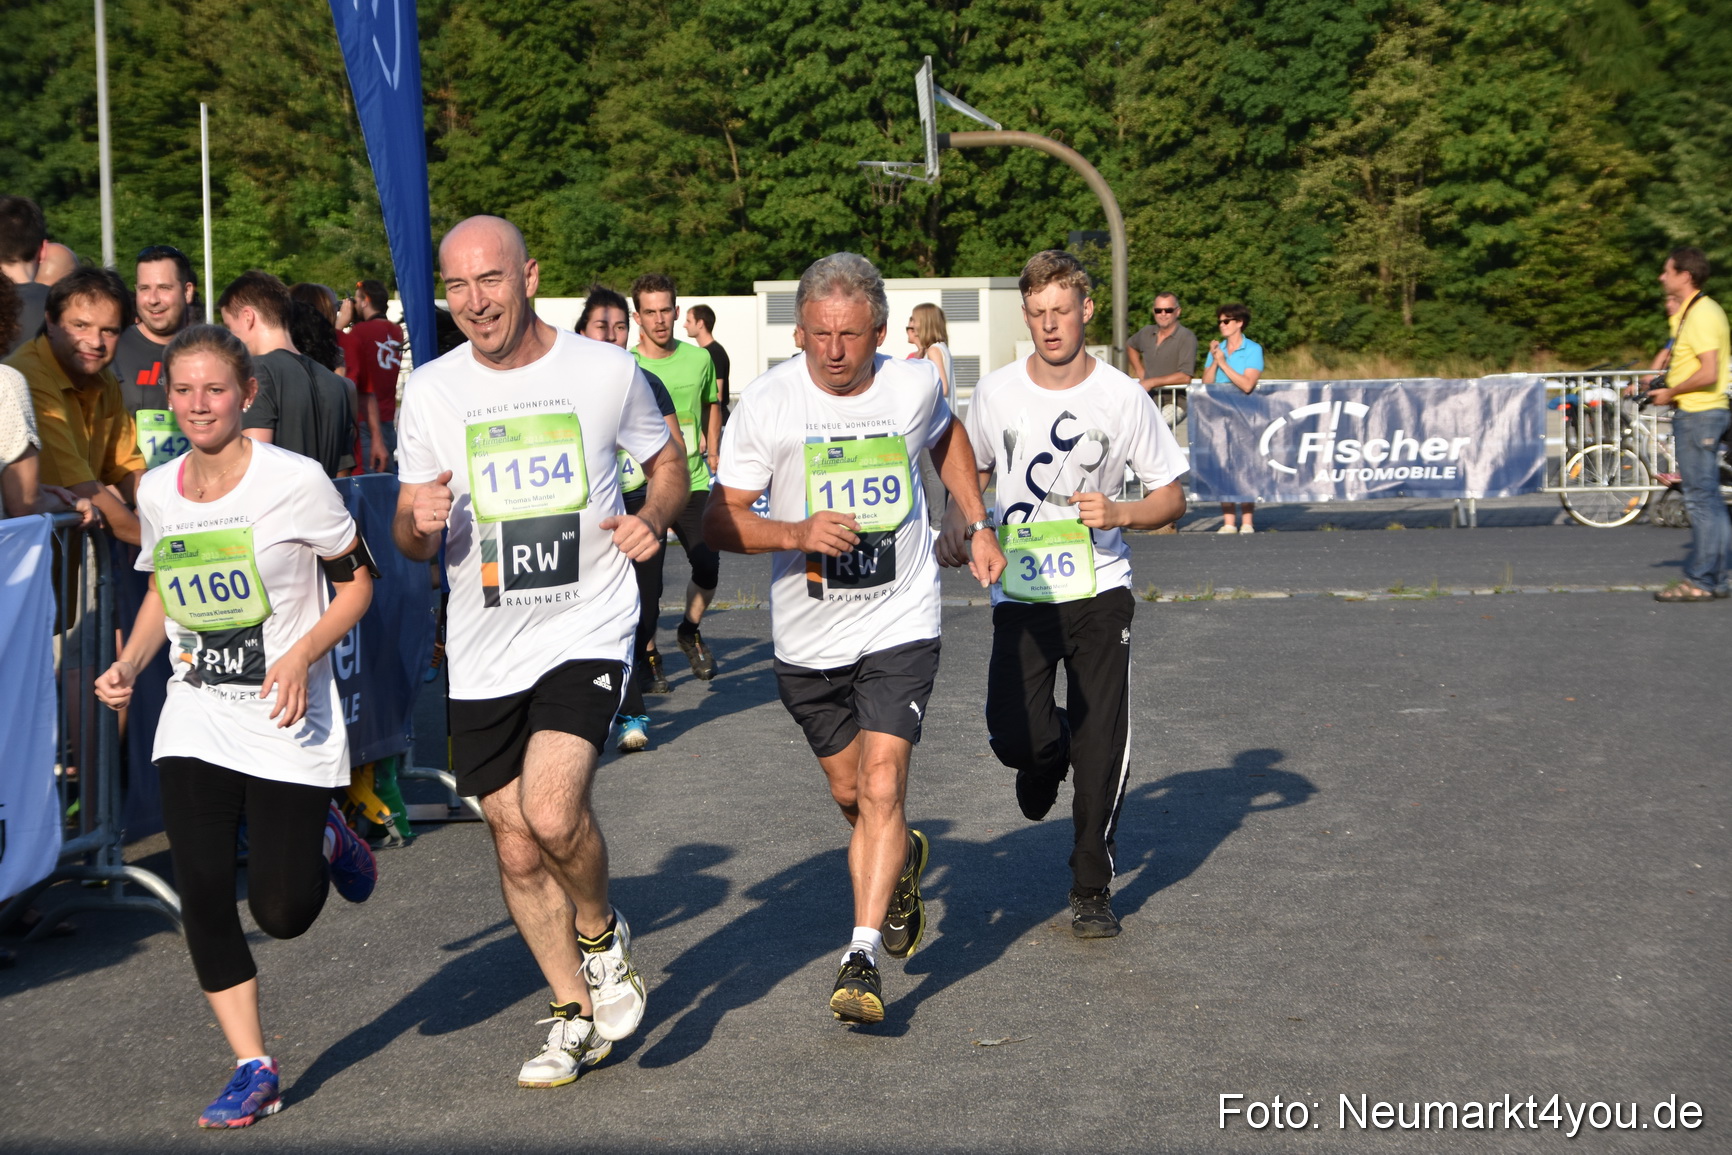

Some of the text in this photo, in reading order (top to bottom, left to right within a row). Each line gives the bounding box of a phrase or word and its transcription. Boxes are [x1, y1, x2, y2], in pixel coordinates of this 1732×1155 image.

[467, 398, 572, 418] DIE NEUE WOHNFORMEL
[821, 422, 842, 430] NEUE
[845, 419, 897, 430] WOHNFORMEL
[147, 436, 190, 456] 142
[1297, 430, 1470, 463] Fischer
[481, 452, 574, 493] 1154
[1314, 466, 1456, 483] AUTOMOBILE
[504, 493, 556, 506] Thomas Mantel
[819, 474, 901, 509] 1159
[176, 522, 194, 530] NEUE
[197, 515, 250, 528] WOHNFORMEL
[562, 530, 575, 540] NM
[512, 540, 560, 575] RW
[836, 547, 879, 576] RW
[1020, 552, 1075, 581] 346
[168, 569, 251, 606] 1160
[506, 588, 581, 606] RAUMWERK
[829, 586, 895, 602] RAUMWERK
[189, 607, 243, 618] Thomas Kleesattel
[245, 638, 258, 647] NM
[203, 647, 244, 674] RW
